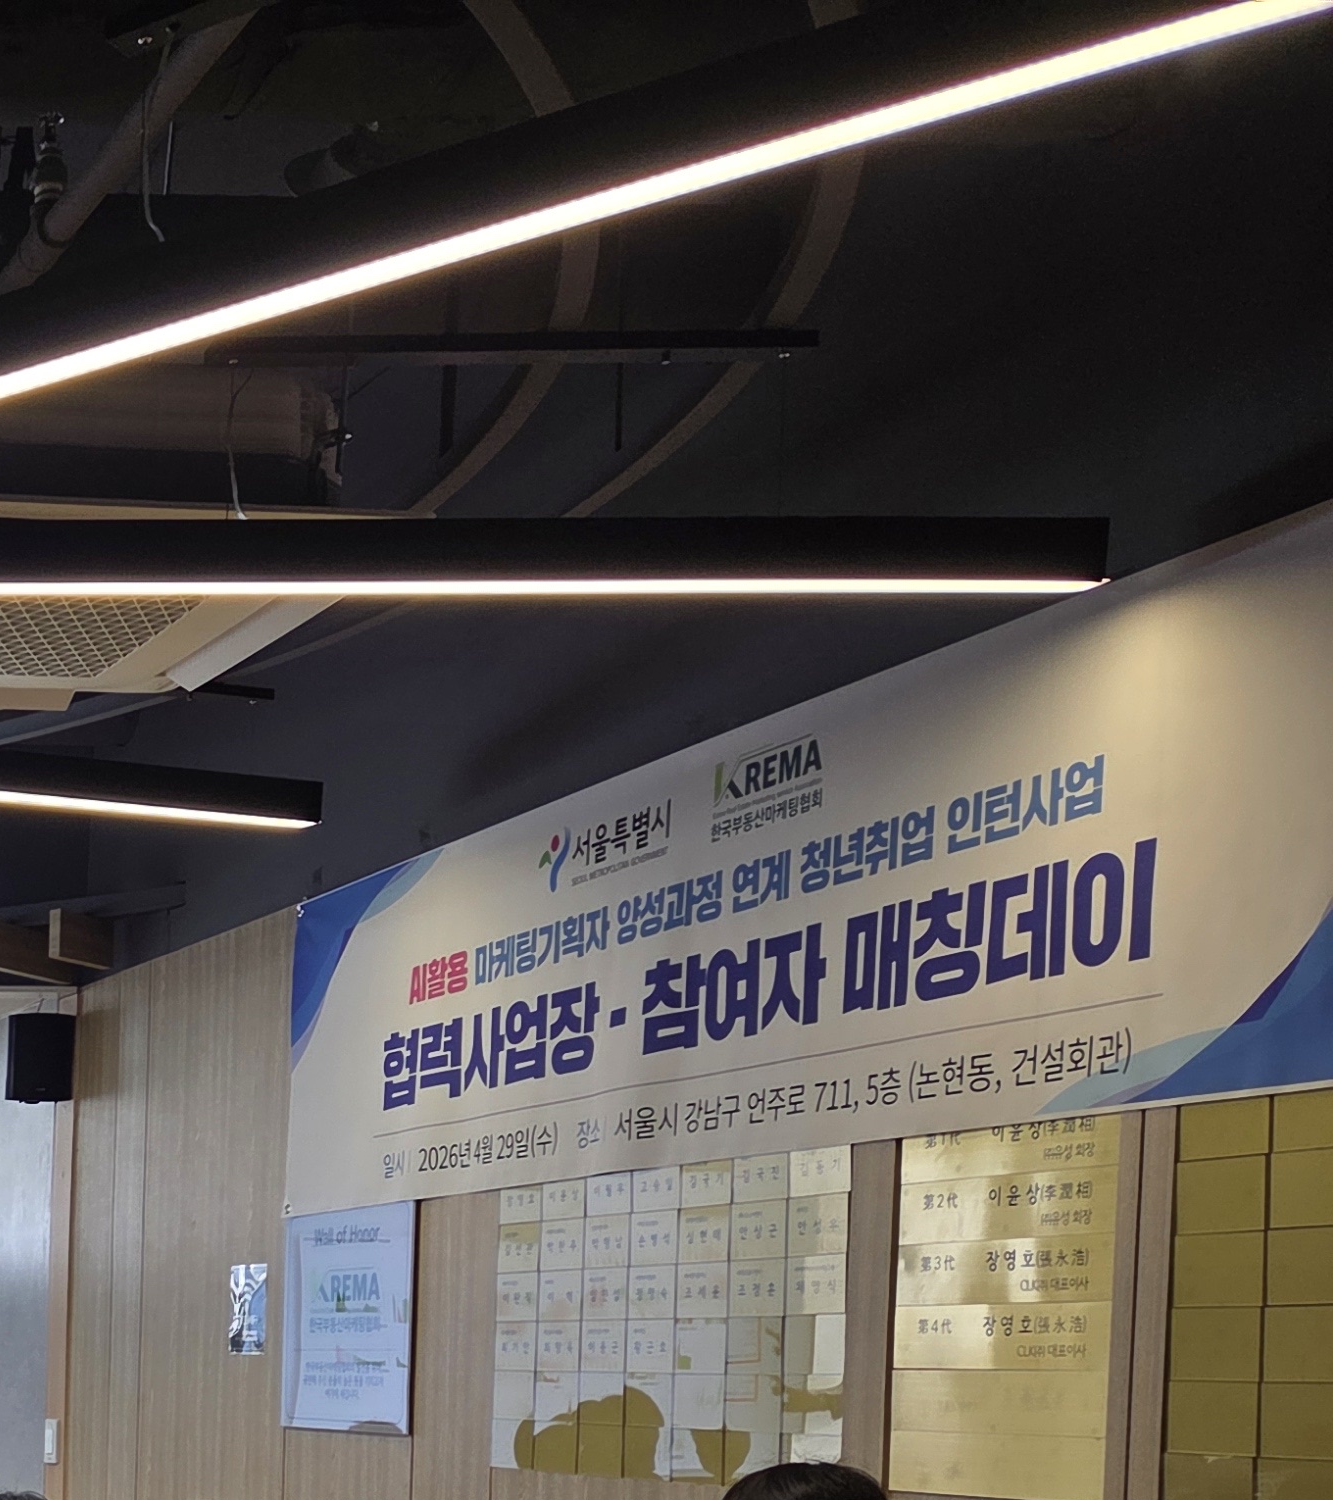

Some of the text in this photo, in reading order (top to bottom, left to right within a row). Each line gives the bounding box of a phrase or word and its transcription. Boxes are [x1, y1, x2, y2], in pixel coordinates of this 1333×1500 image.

[711, 788, 823, 843] 한국부동산마케팅협회
[713, 739, 822, 807] KREMA
[409, 754, 1105, 1004] AI활용 마케팅기획자 양성과정 연계 청년취업 인턴사업
[572, 798, 671, 866] 서울특별시
[383, 981, 600, 1111] 협력사업장
[642, 922, 826, 1055] 참여자
[843, 837, 1157, 1014] 매칭데이
[383, 1026, 1132, 1179] 일시 2026년 4월 29일(수) 장소 서울시 강남구 언주로 711, 5층 (논현동, 건설회관)
